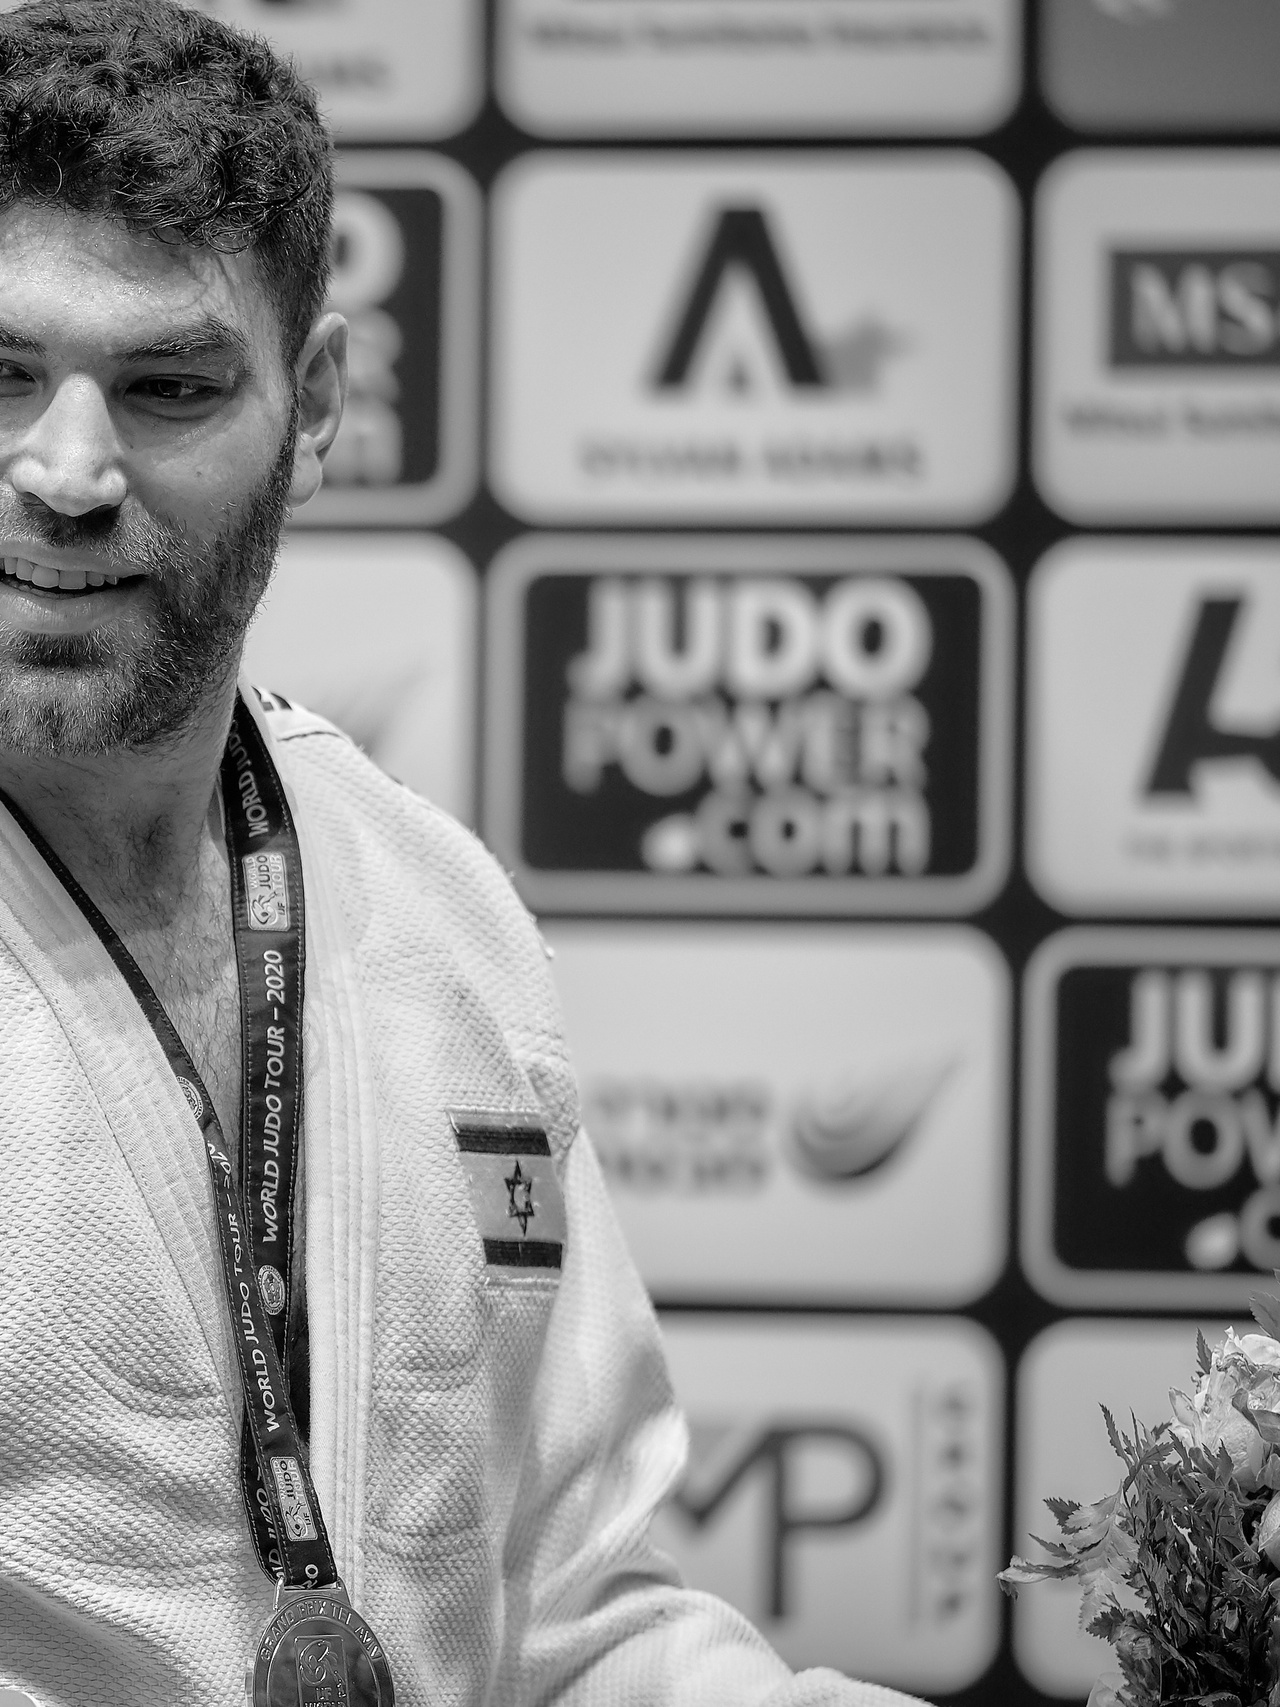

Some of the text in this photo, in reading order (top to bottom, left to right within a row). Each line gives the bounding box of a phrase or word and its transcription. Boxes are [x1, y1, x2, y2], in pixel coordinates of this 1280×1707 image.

[567, 572, 933, 703] JUDO
[562, 690, 931, 797] POWER
[238, 770, 269, 838] WORLD
[641, 790, 932, 879] .com
[246, 856, 259, 889] WORLD
[256, 854, 272, 890] JUDO
[270, 852, 284, 890] TOUR
[262, 949, 286, 1005] 2020
[264, 1024, 286, 1089] TOUR
[263, 1094, 283, 1157] JUDO
[259, 1159, 280, 1244] WORLD
[228, 1212, 244, 1277] TOUR
[238, 1281, 260, 1345] JUDO
[251, 1348, 281, 1433] WORLD
[279, 1460, 296, 1500] JUDO
[260, 1600, 383, 1662] GRAND PRIX TEL AVIV
